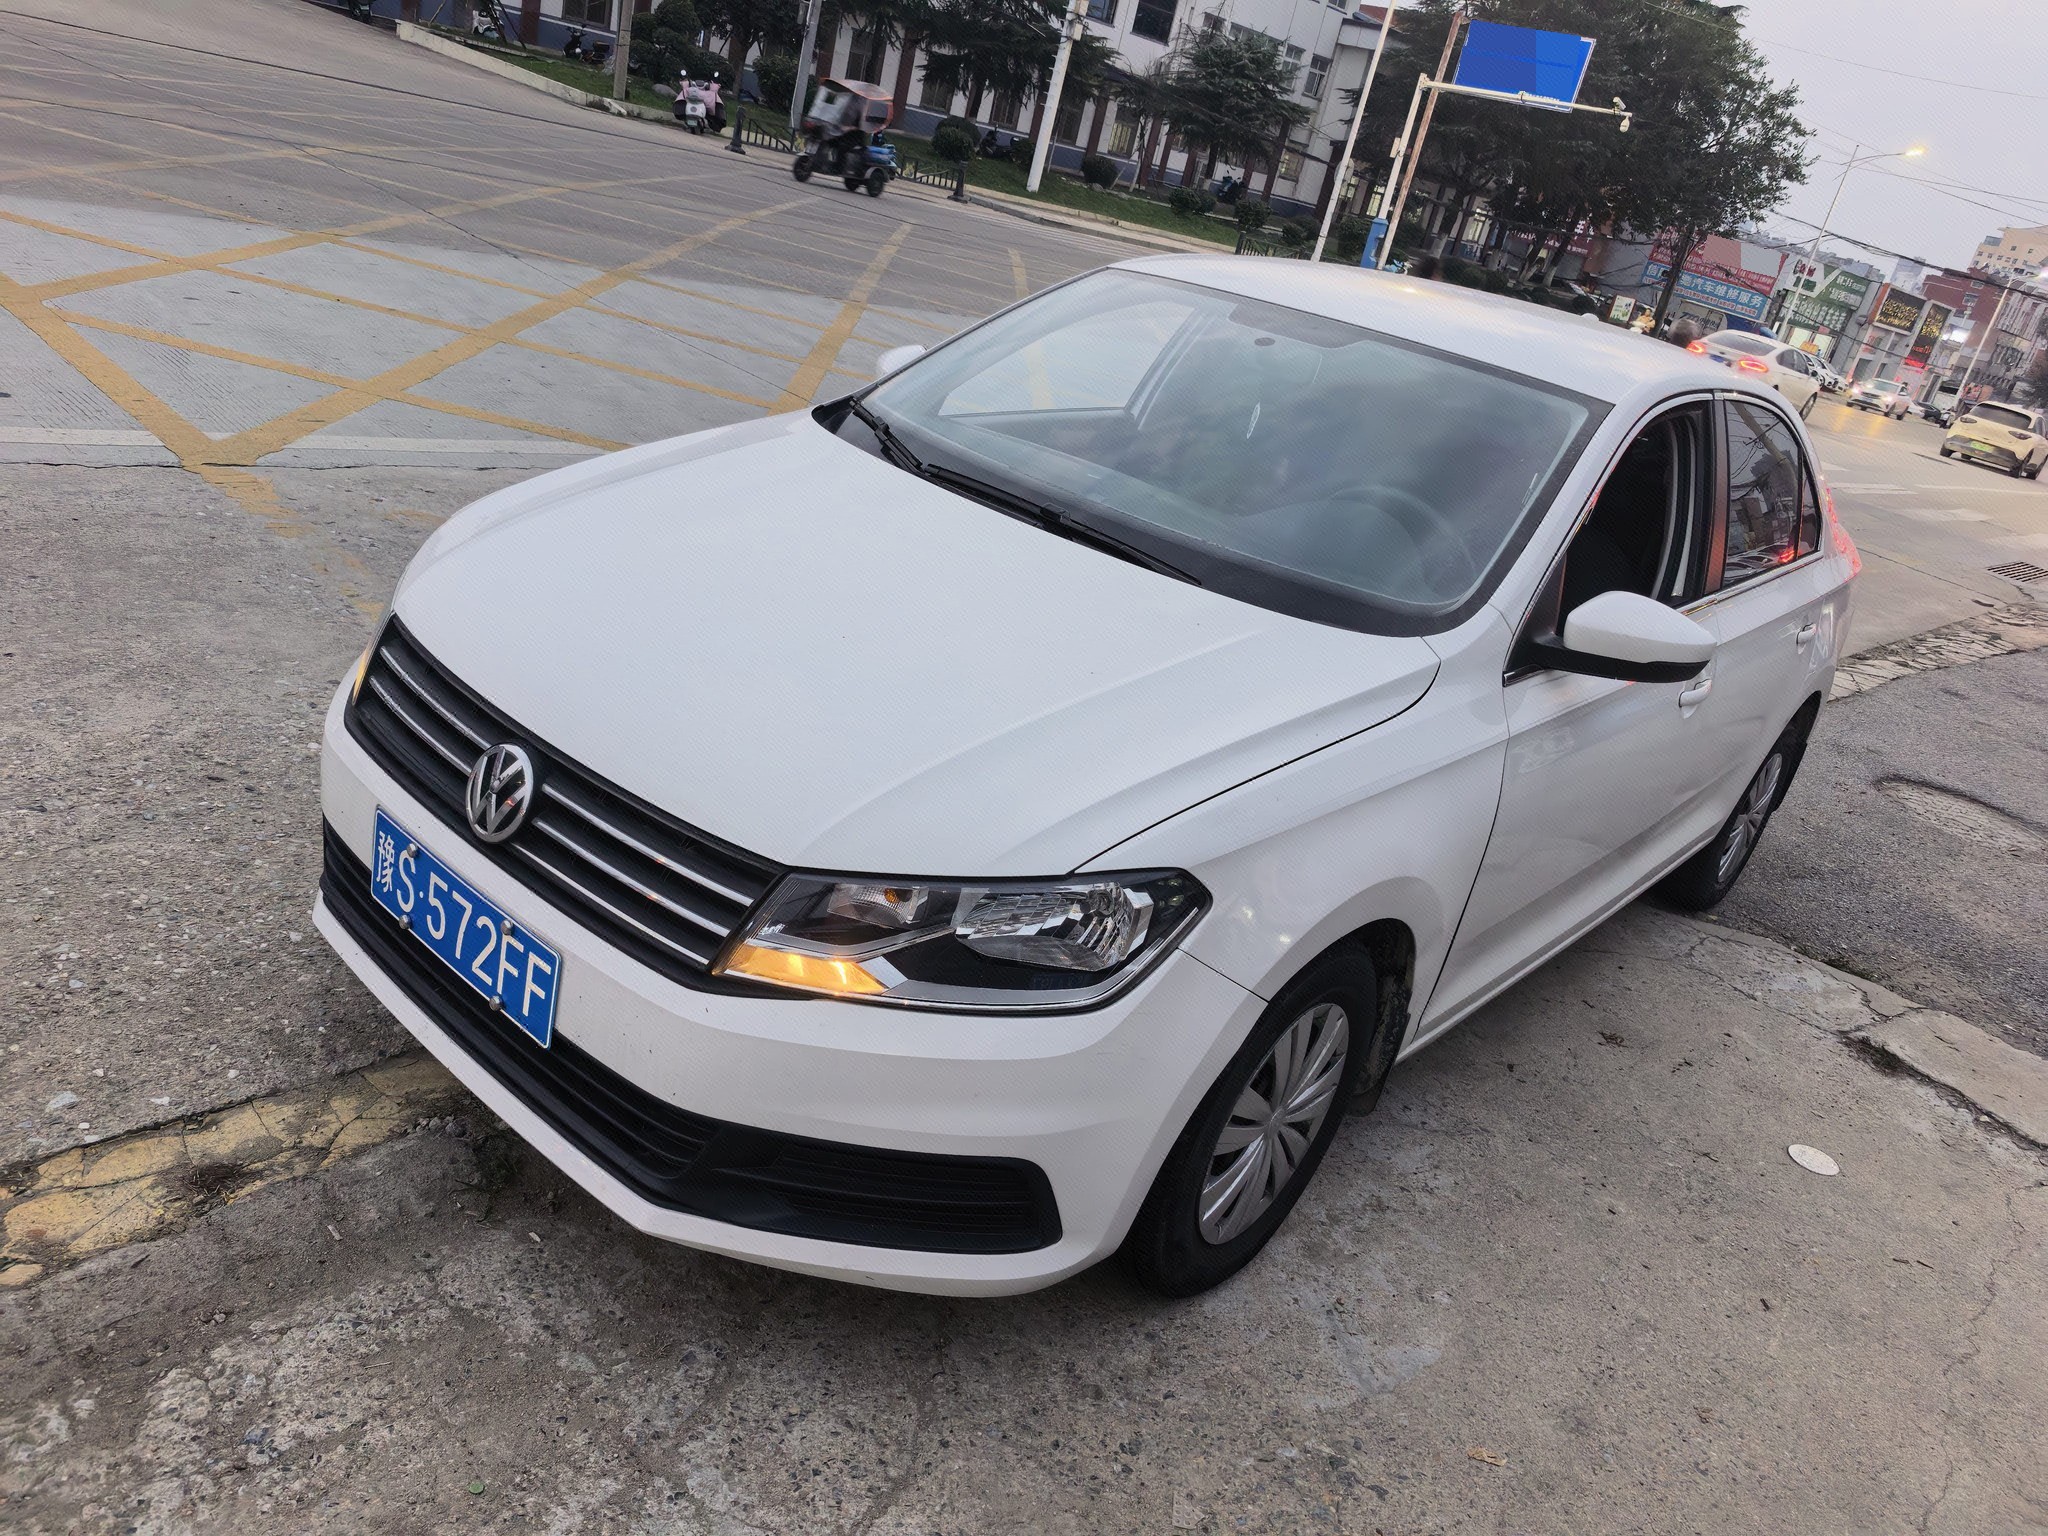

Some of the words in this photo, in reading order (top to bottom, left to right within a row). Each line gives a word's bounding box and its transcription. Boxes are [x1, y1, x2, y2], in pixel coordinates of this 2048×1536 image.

[1647, 263, 1764, 308] 信汽车维修服务
